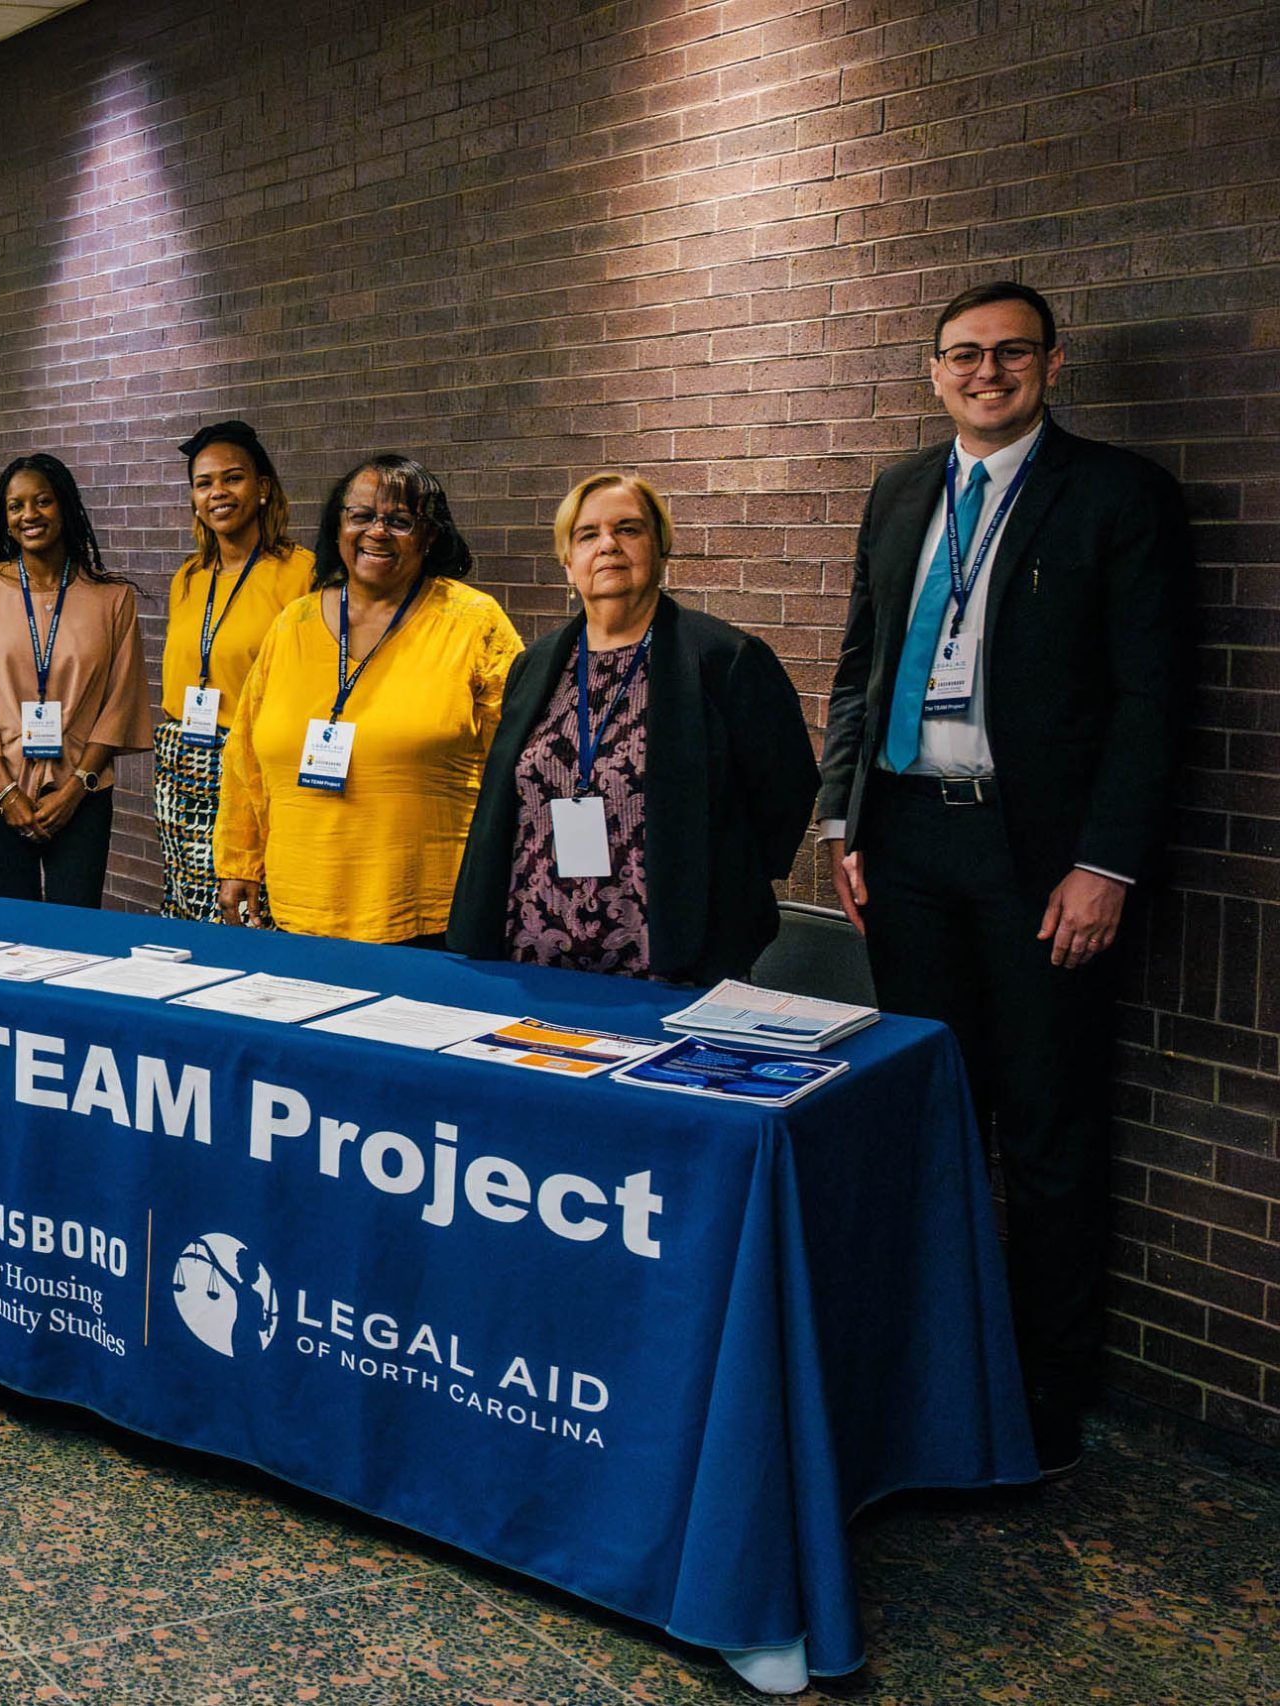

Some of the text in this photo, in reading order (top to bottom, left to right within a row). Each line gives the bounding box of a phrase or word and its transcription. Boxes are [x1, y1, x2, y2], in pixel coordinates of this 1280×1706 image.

[249, 1079, 663, 1259] Project
[5, 1262, 103, 1315] Housing
[49, 1308, 126, 1357] Studies
[296, 1336, 604, 1449] OF NORTH CAROLINA
[297, 1289, 609, 1413] LEGAL AID
